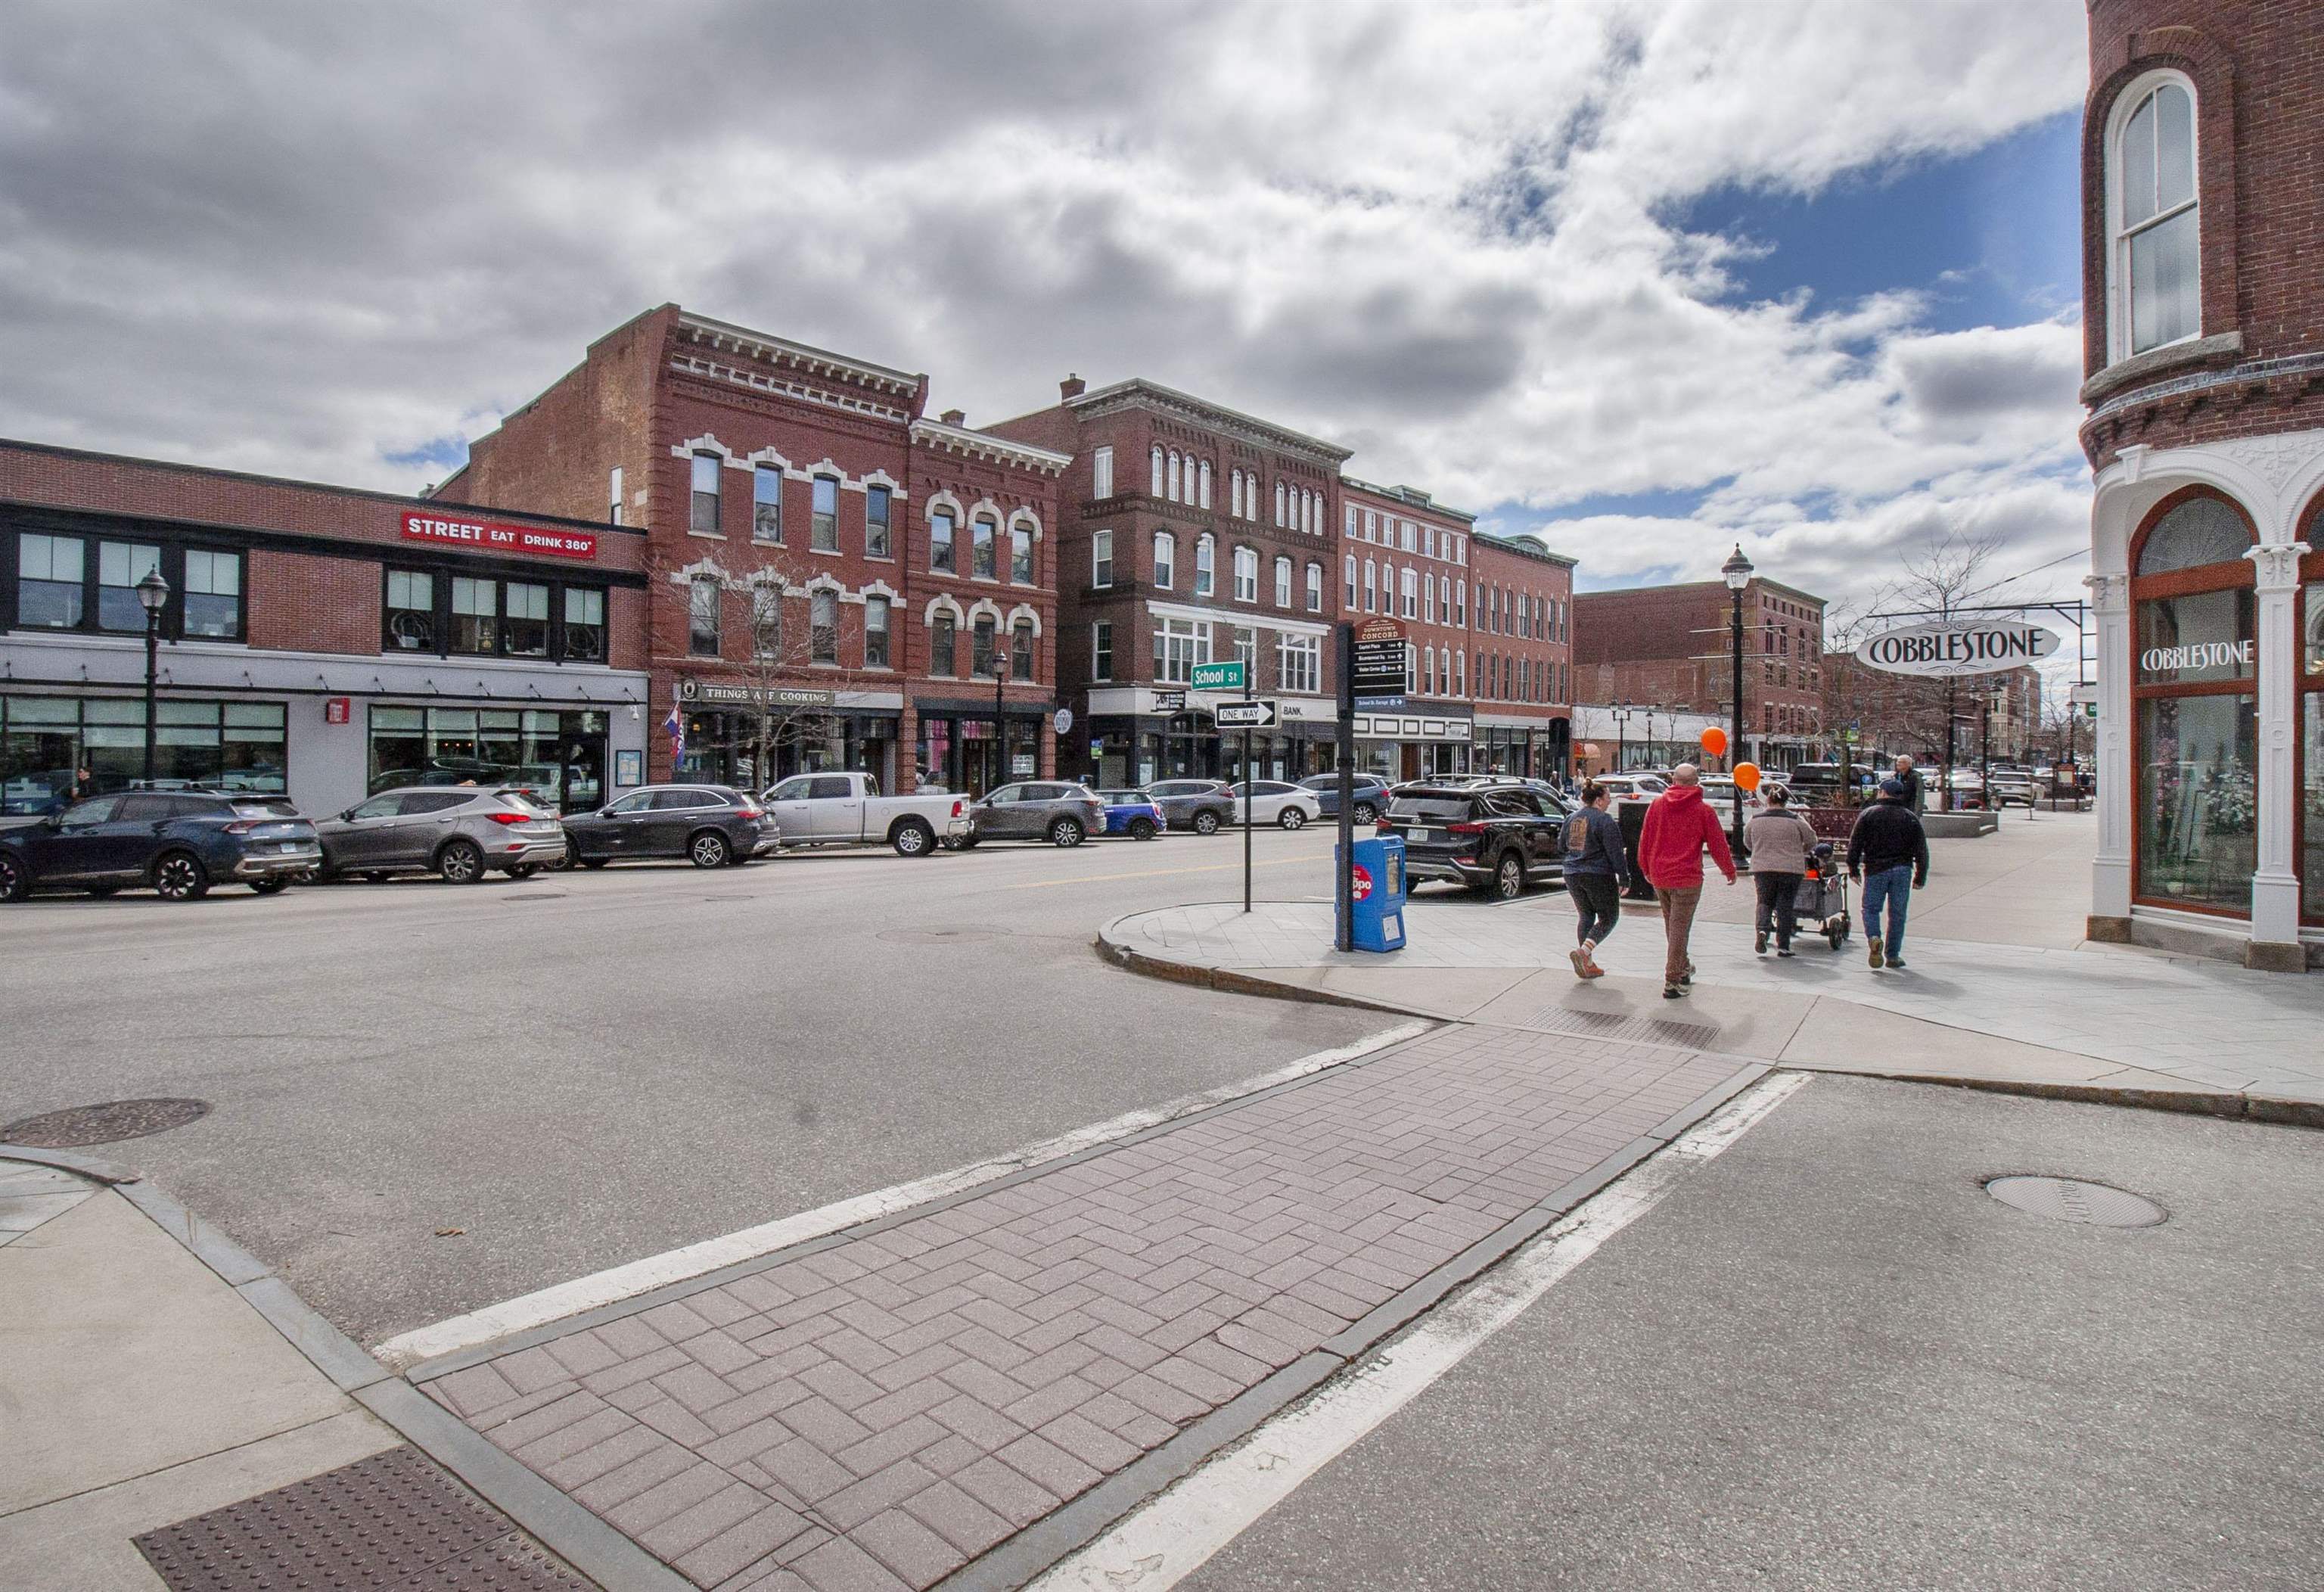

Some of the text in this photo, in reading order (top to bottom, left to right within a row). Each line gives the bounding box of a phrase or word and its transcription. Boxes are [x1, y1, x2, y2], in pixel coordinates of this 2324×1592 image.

[409, 518, 483, 540] STREET
[491, 530, 515, 542] EAT
[524, 534, 562, 548] DRINK
[1362, 631, 1398, 640] CONCORD
[1869, 628, 2044, 664] COBBLESTONE
[2142, 639, 2254, 671] COBBLESTONE
[1195, 668, 1237, 685] School St
[707, 689, 748, 699] THINGS
[780, 692, 827, 702] COOKING
[1223, 708, 1259, 720] ONE WAY
